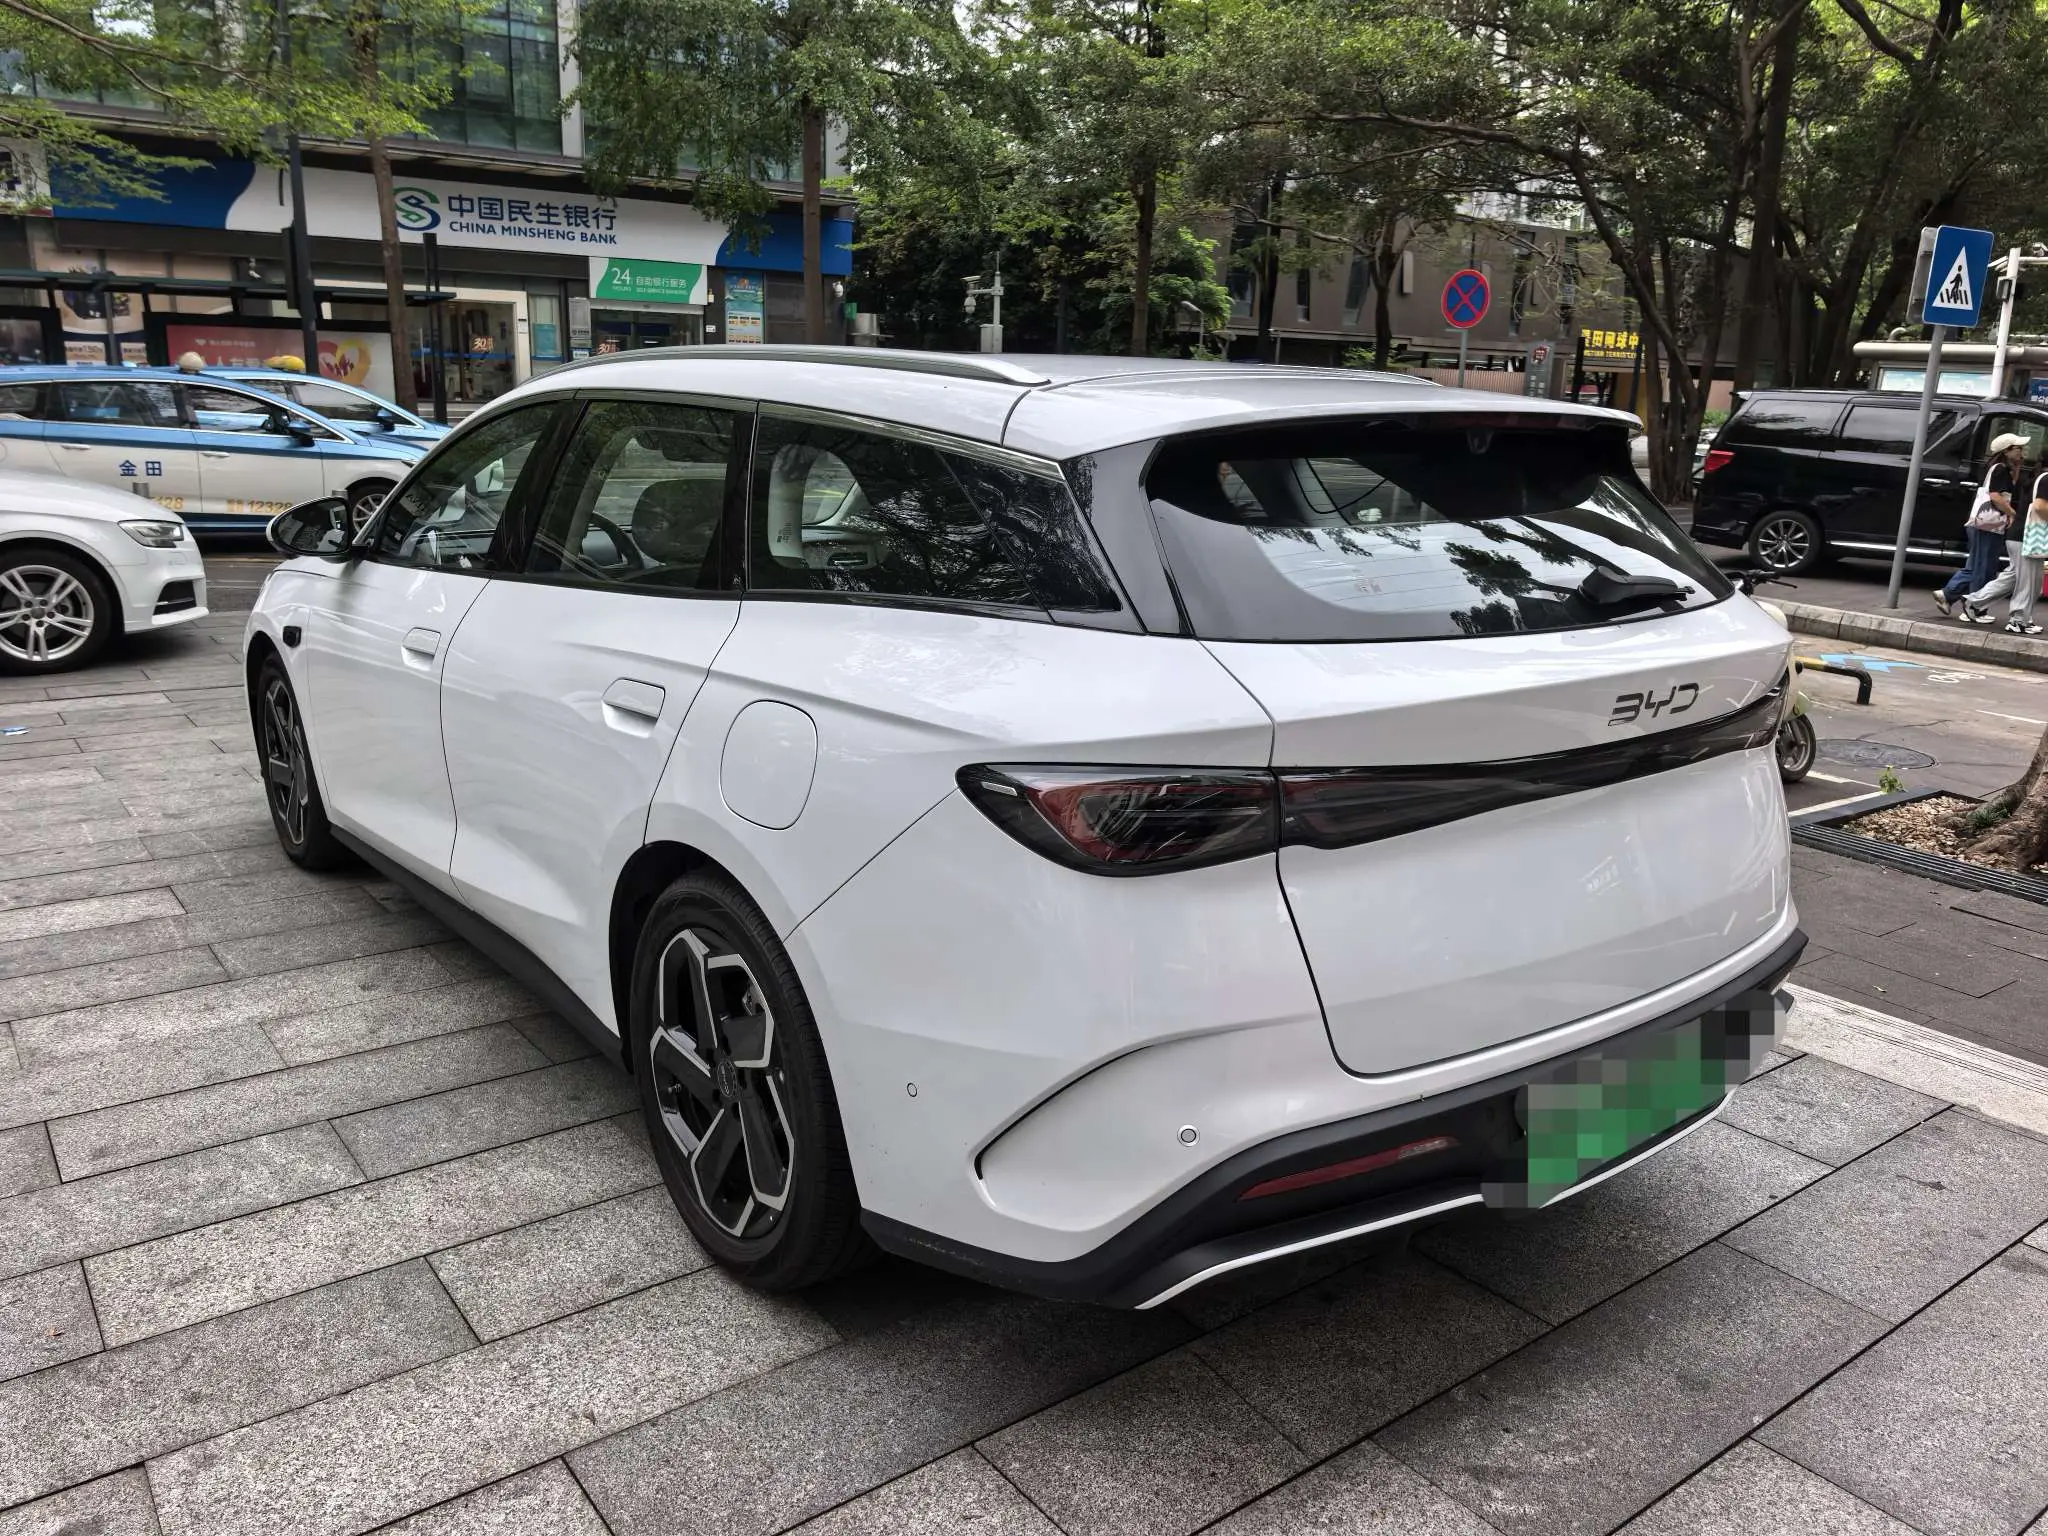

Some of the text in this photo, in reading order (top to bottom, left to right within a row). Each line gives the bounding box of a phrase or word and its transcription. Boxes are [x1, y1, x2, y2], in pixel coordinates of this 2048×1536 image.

[447, 194, 617, 231] 中国民生银行
[449, 221, 617, 245] CHINA MINSHENG BANK
[611, 267, 631, 285] 24
[119, 460, 162, 477] 金田
[1607, 682, 1700, 727] BYD
